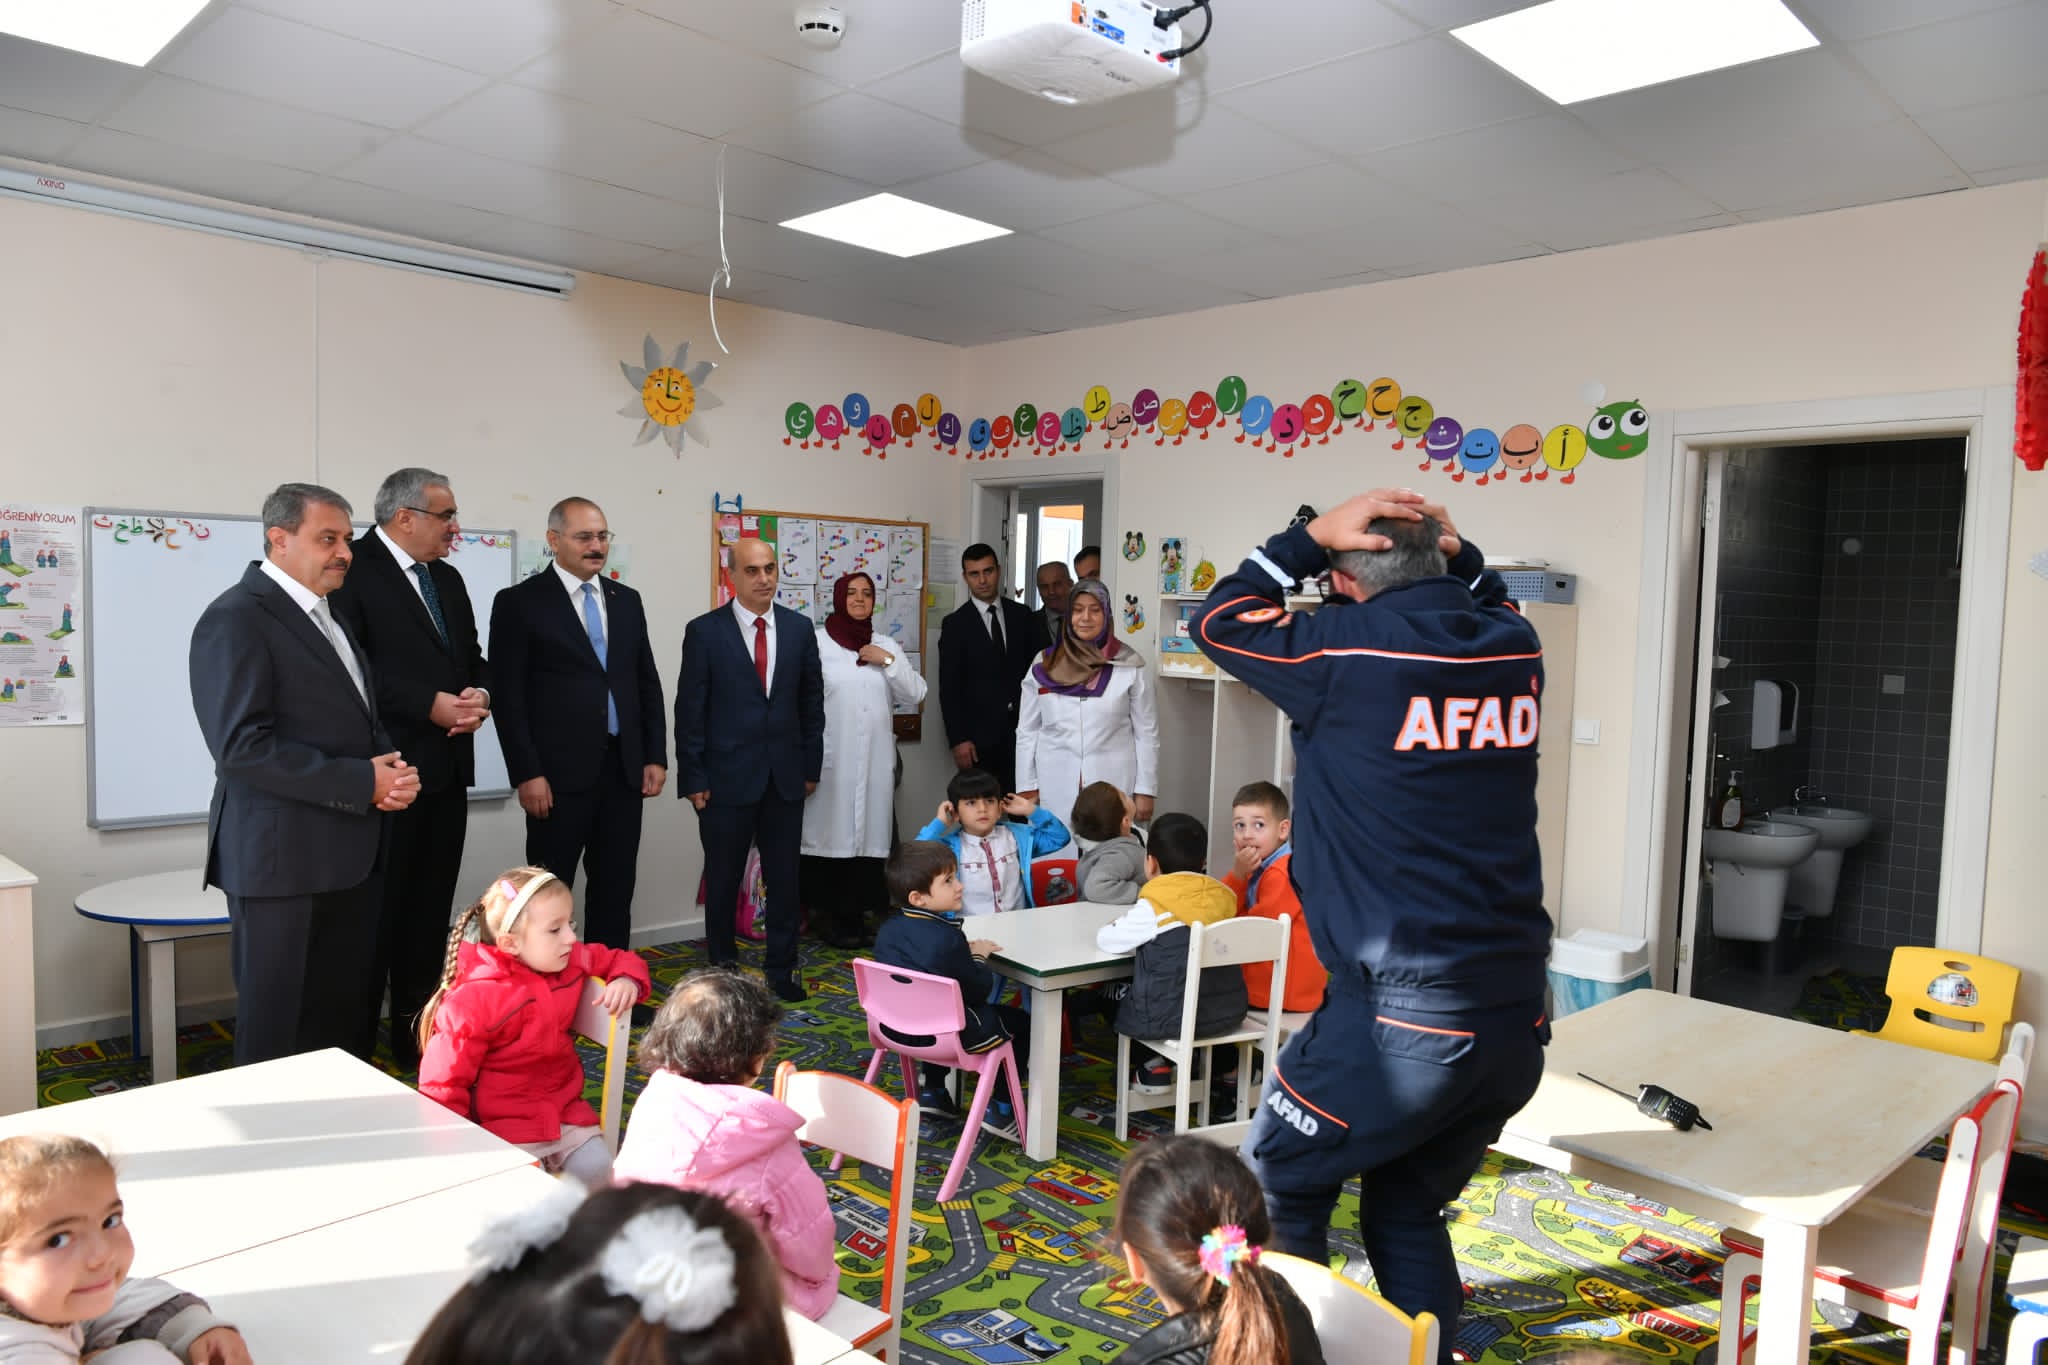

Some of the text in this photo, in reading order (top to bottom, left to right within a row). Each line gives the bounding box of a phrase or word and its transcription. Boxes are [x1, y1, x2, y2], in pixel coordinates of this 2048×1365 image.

[1090, 391, 1106, 414] ط
[1134, 400, 1158, 416] ص
[1223, 377, 1238, 414] ز
[1338, 380, 1361, 419] خ
[1372, 385, 1393, 416] ح
[849, 402, 861, 420] و
[900, 410, 909, 433] م
[921, 398, 934, 420] ل
[1020, 404, 1033, 435] غ
[1107, 410, 1131, 430] ض
[1188, 400, 1212, 419] س
[1247, 403, 1265, 428] ر
[1310, 402, 1325, 424] د
[1404, 405, 1422, 431] ج
[871, 418, 884, 440] ن
[972, 418, 986, 444] ق
[1042, 418, 1054, 442] ع
[1063, 413, 1082, 438] ظ
[1279, 406, 1294, 438] ذ
[1427, 425, 1460, 450] ث
[1464, 442, 1494, 459] ت
[1503, 439, 1539, 464] ب
[1393, 695, 1539, 751] AFAD
[1266, 1090, 1319, 1136] AFAD
